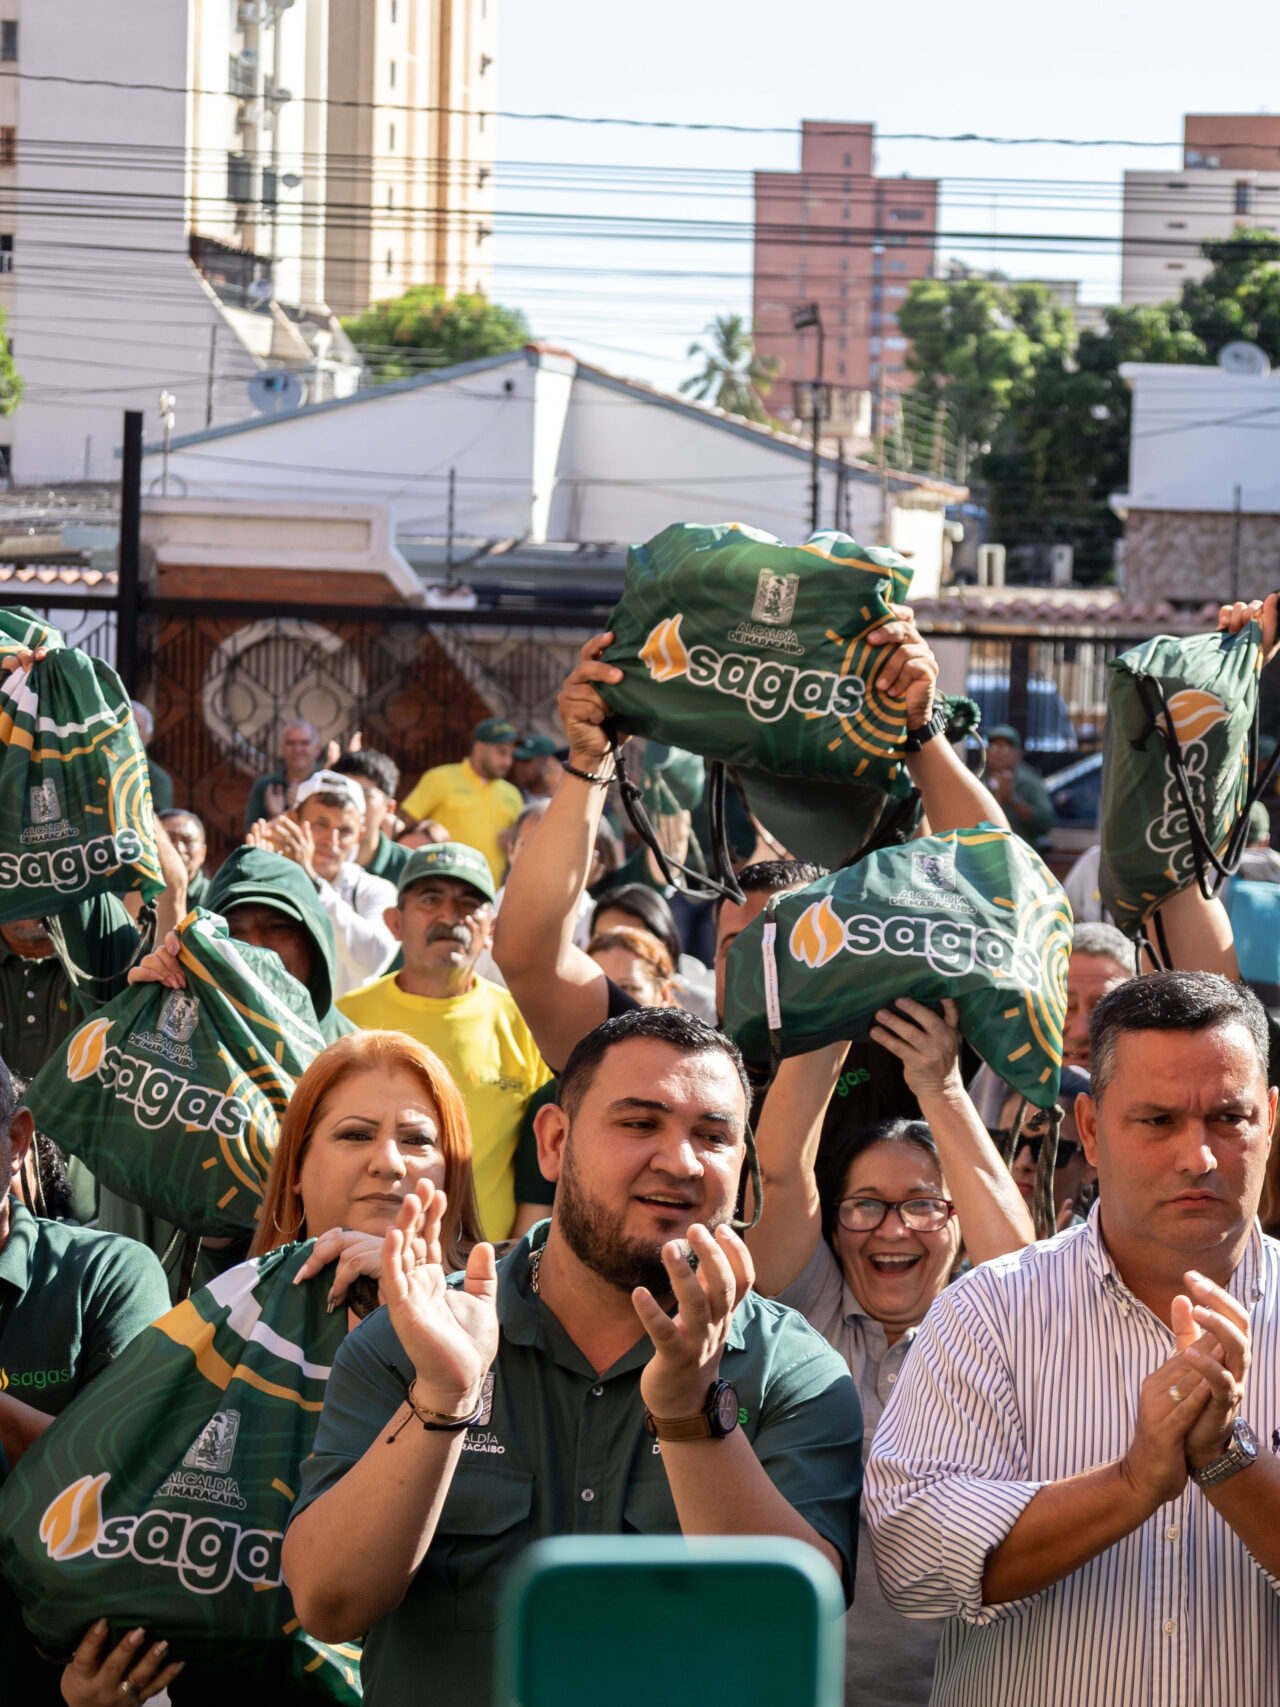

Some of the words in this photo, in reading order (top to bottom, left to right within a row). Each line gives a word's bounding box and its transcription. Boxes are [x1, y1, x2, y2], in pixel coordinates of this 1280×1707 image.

[686, 645, 865, 722] sagas
[0, 828, 144, 893] sagas
[843, 914, 1042, 991] sagas
[98, 1046, 251, 1139] sagas
[836, 1067, 871, 1097] gas
[10, 1368, 71, 1389] sagas
[461, 1443, 505, 1454] RACAIBO
[464, 1432, 498, 1445] ALDÍA
[171, 1484, 247, 1510] MARACAIBO
[93, 1509, 285, 1594] saga
